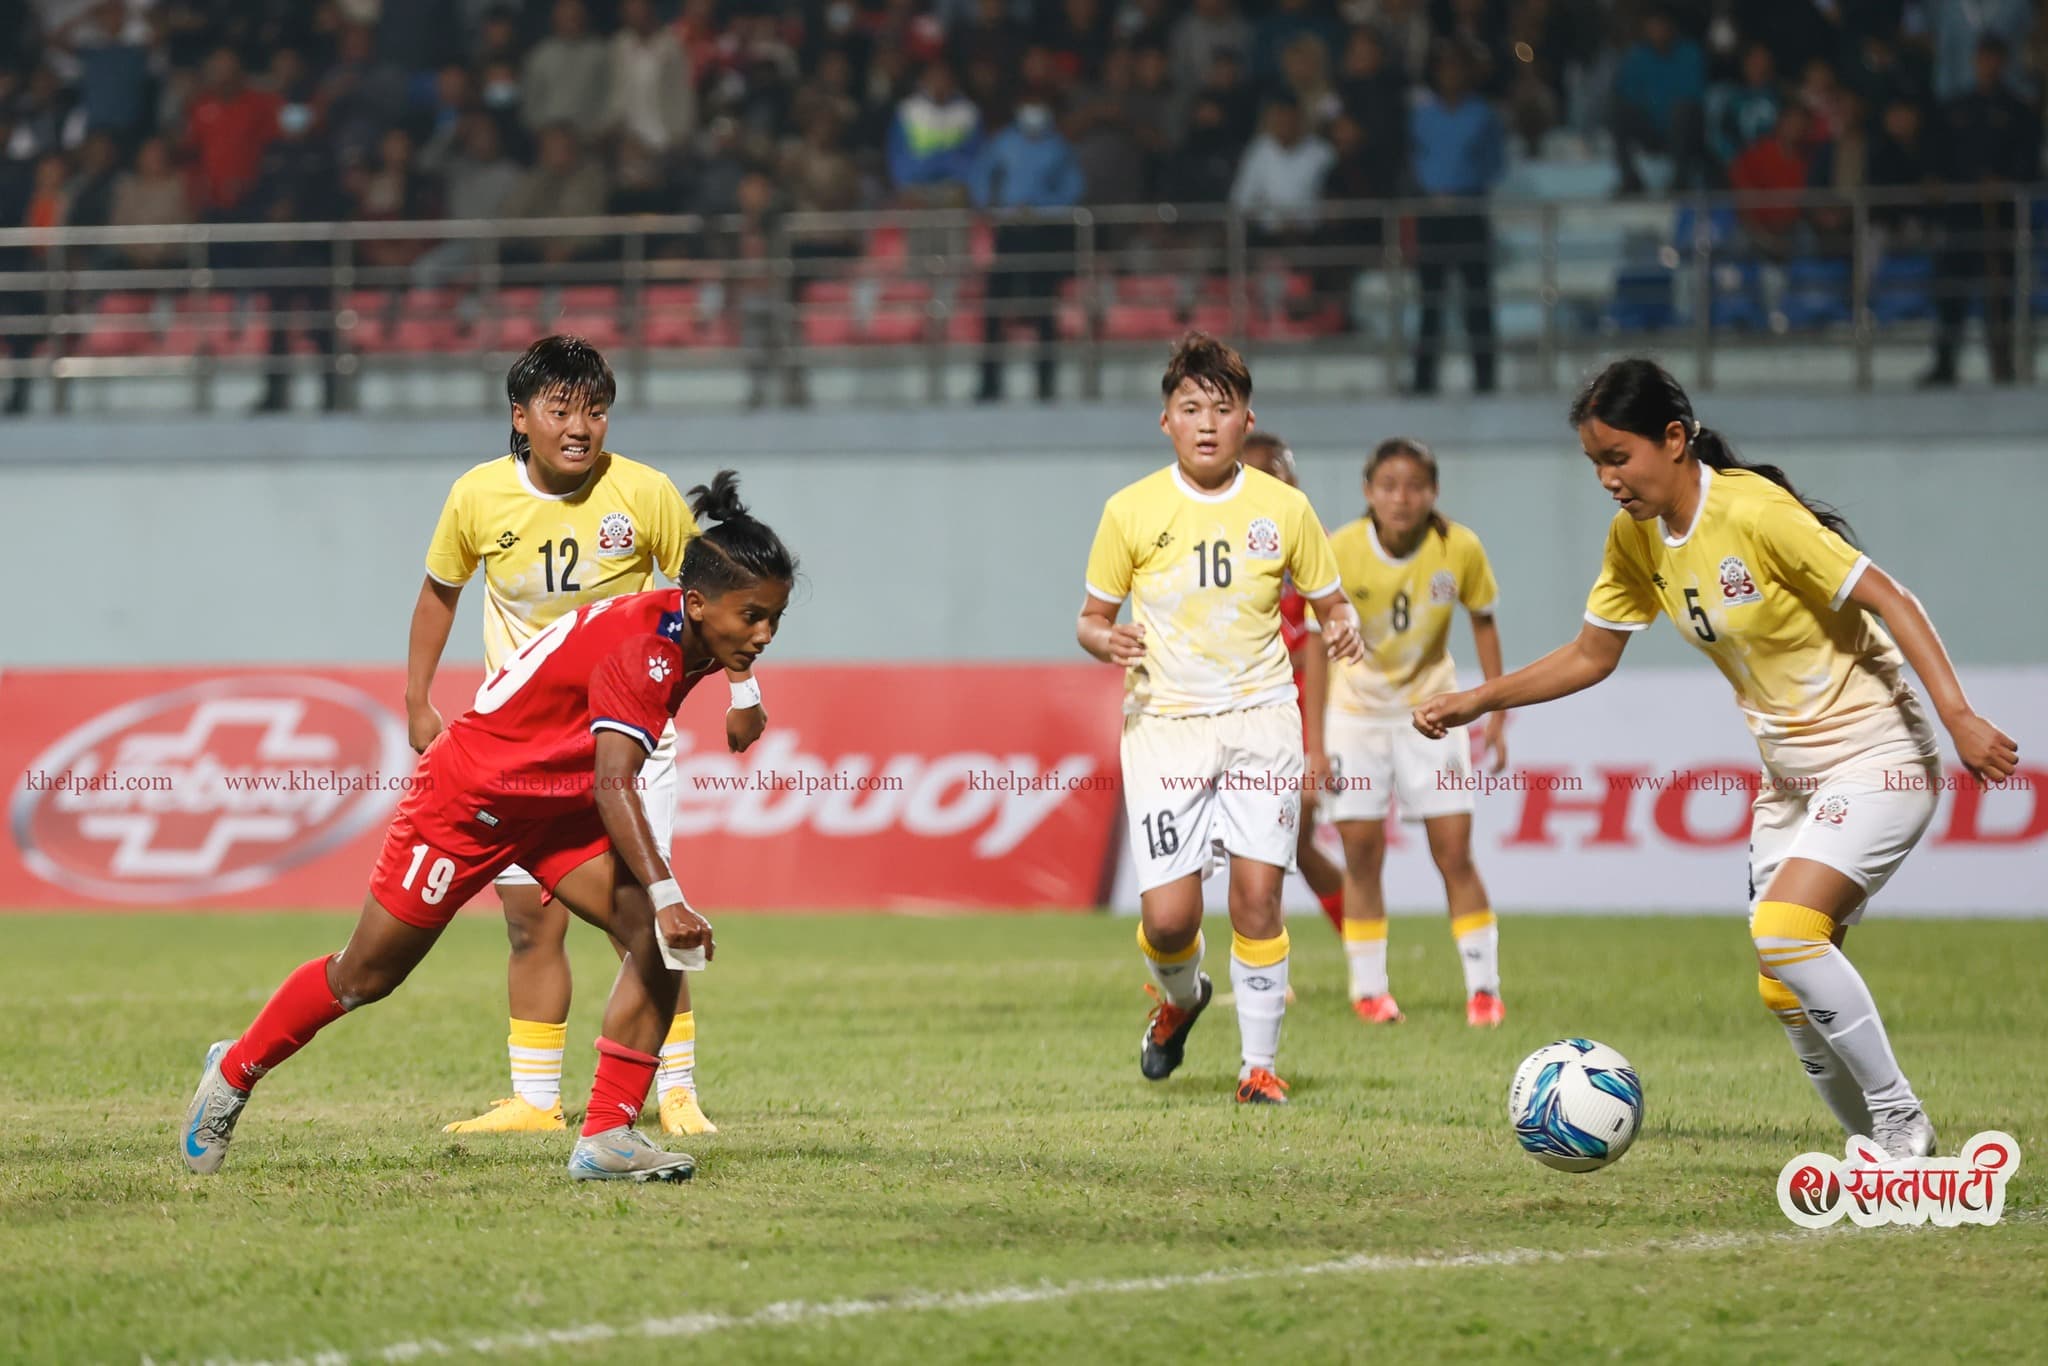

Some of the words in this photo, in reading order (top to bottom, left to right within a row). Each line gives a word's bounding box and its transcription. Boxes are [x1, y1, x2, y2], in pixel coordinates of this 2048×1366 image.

[538, 537, 580, 593] 12
[1194, 539, 1232, 589] 16
[1391, 591, 1409, 633] 8
[1683, 588, 1717, 642] 5
[675, 728, 1099, 859] ebuoy
[1501, 764, 2048, 848] HOD
[1142, 809, 1179, 860] 16
[402, 843, 456, 905] 19
